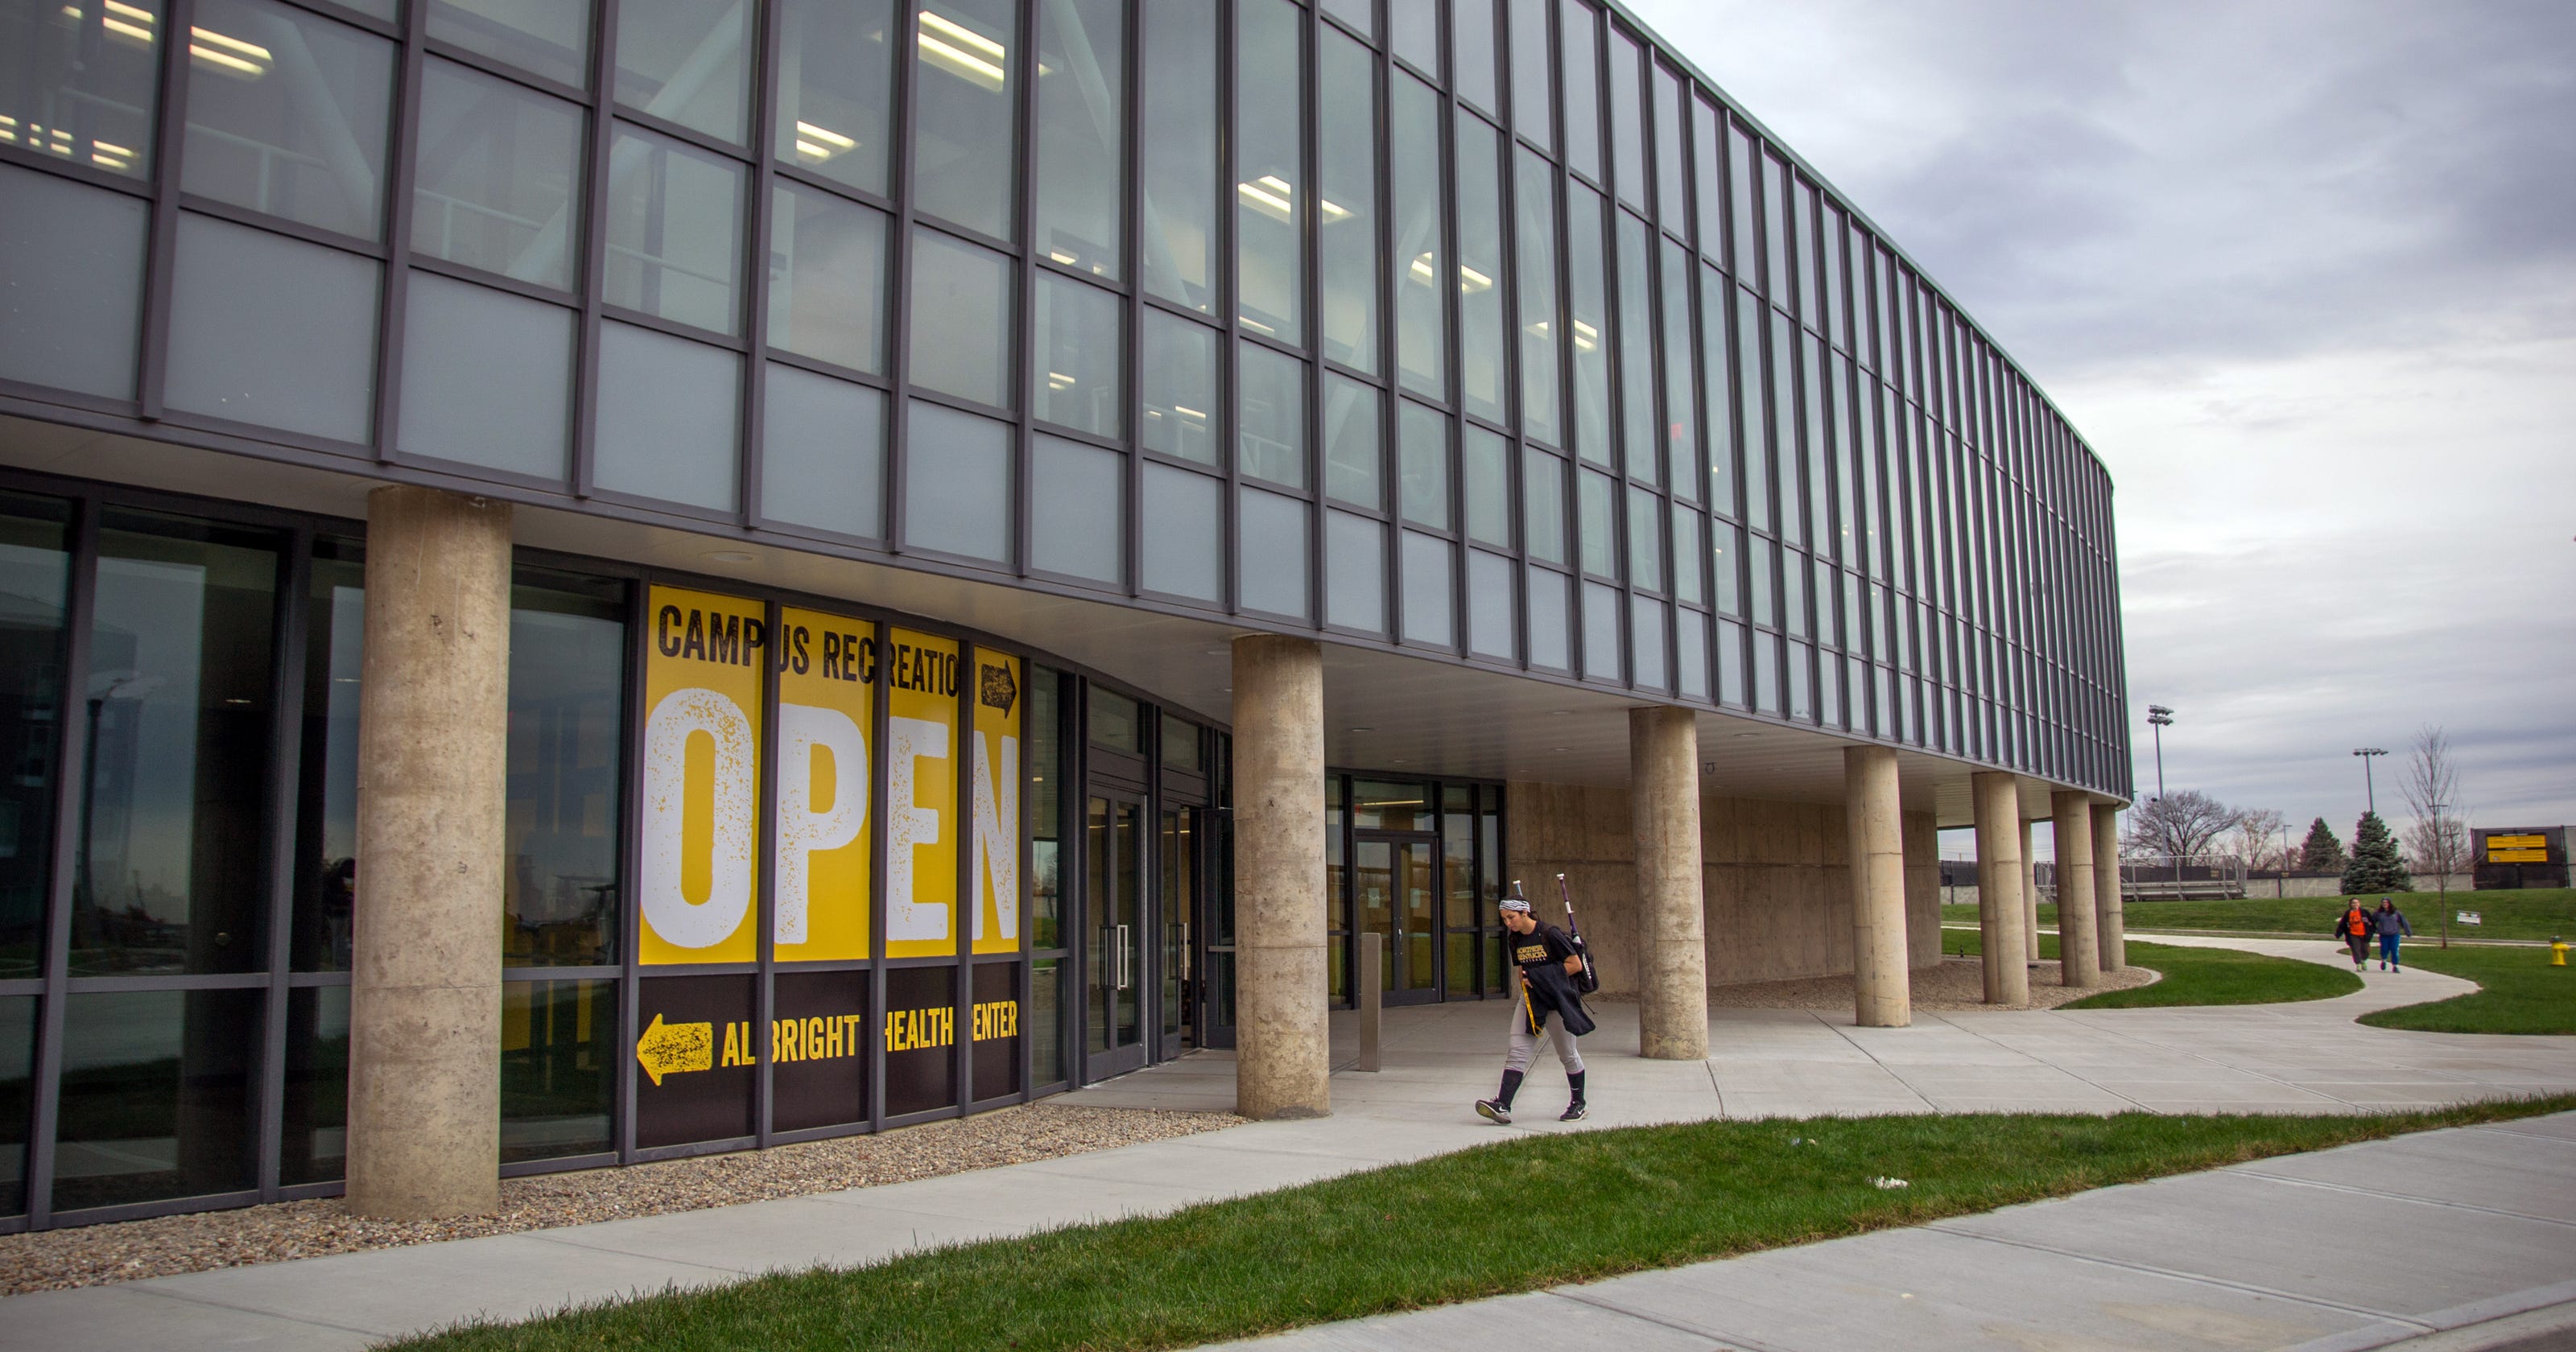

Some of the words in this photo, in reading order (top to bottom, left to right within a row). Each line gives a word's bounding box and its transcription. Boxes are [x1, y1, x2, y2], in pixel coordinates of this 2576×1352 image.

[658, 604, 810, 675] CAMPUS
[824, 631, 975, 702] RECEATIO
[641, 687, 1017, 949] OPEN
[884, 1006, 953, 1052] HEALTH
[972, 1000, 1018, 1041] ENTER
